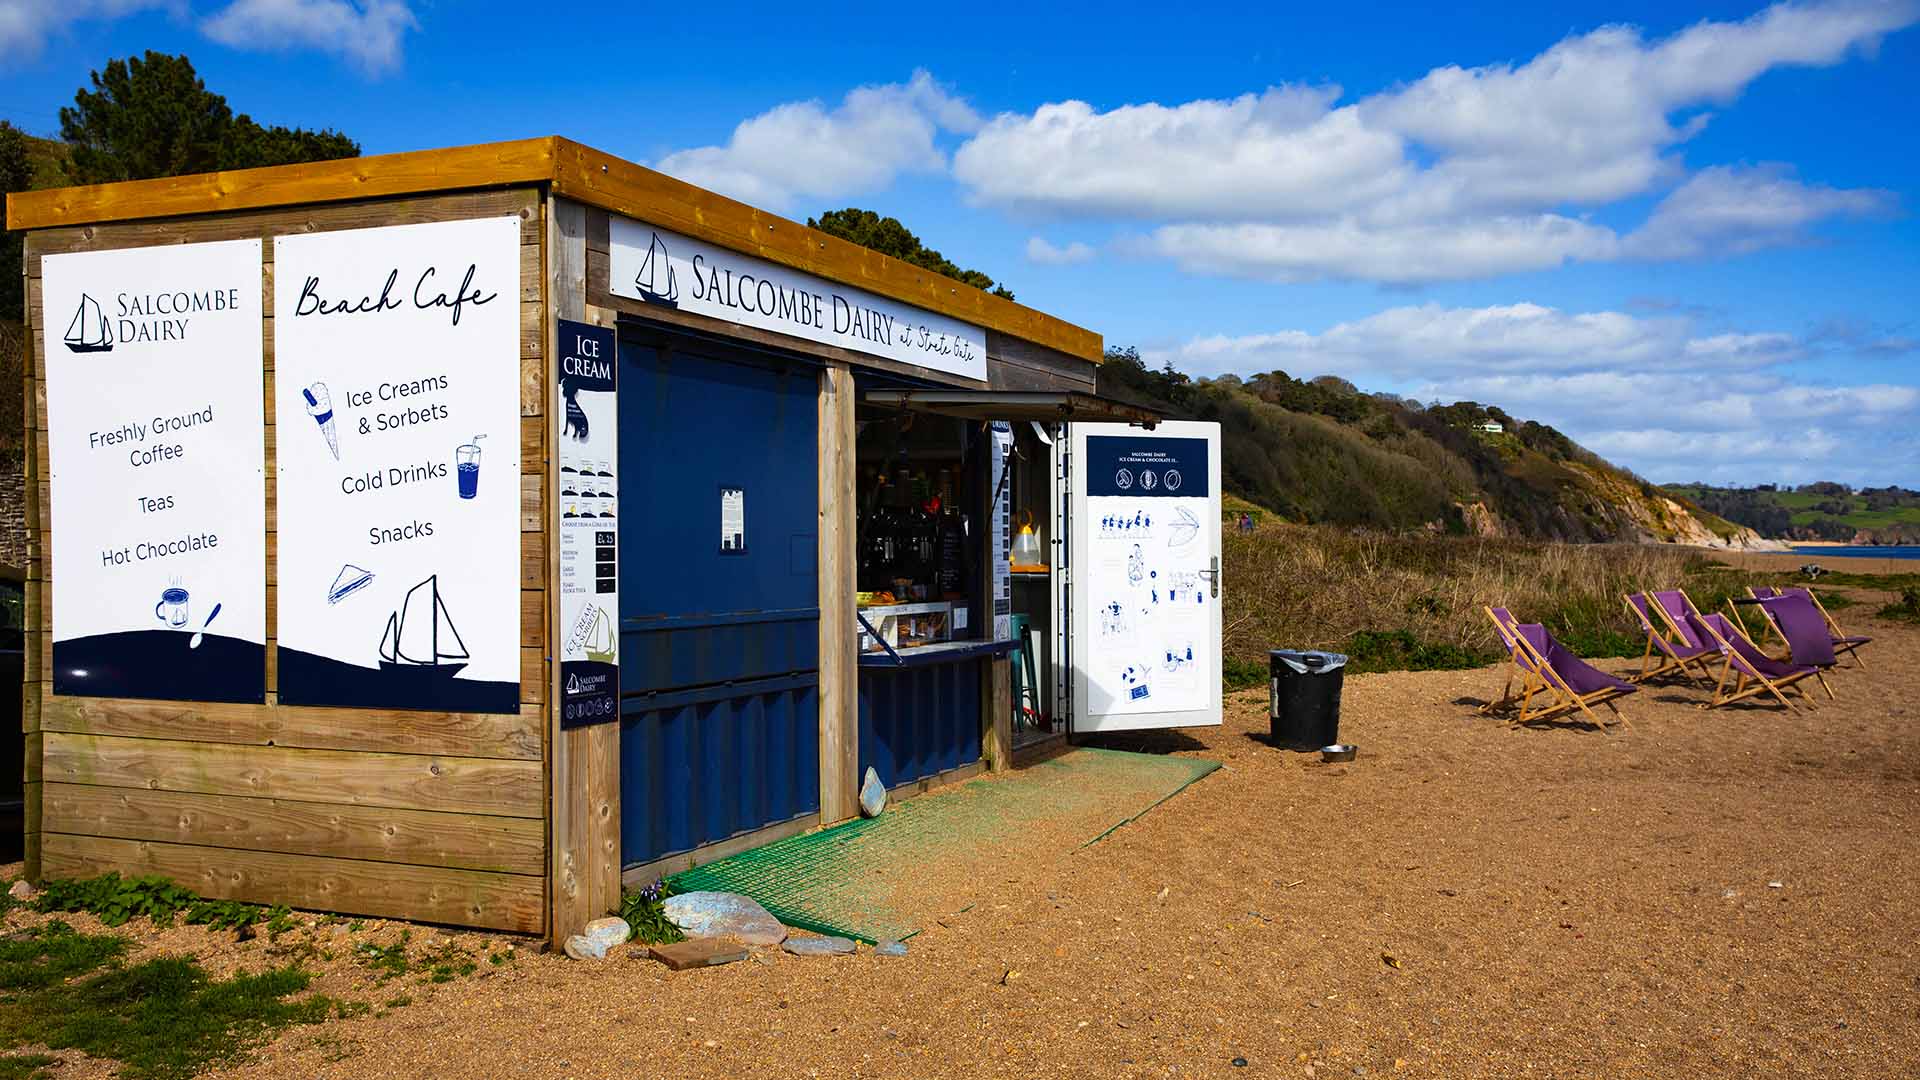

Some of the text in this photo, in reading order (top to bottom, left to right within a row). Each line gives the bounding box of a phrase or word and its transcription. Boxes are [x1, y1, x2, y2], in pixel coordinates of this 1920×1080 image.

[117, 289, 239, 317] SALCOMBE
[295, 263, 498, 327] Beach Cafe
[692, 254, 974, 362] SALCOMBE DAIRY at Strete Gate
[119, 319, 189, 344] DAIRY
[576, 334, 600, 358] ICE
[563, 356, 611, 380] CREAM
[346, 374, 449, 409] Ice Creams
[89, 404, 213, 449] Freshly Ground
[358, 403, 449, 435] & Sorbets
[130, 443, 183, 467] Coffee
[341, 461, 448, 495] Cold Drinks
[138, 495, 175, 513] Teas
[369, 519, 434, 545] Snacks
[102, 532, 218, 567] Hot Chocolate
[575, 602, 594, 637] CREAM
